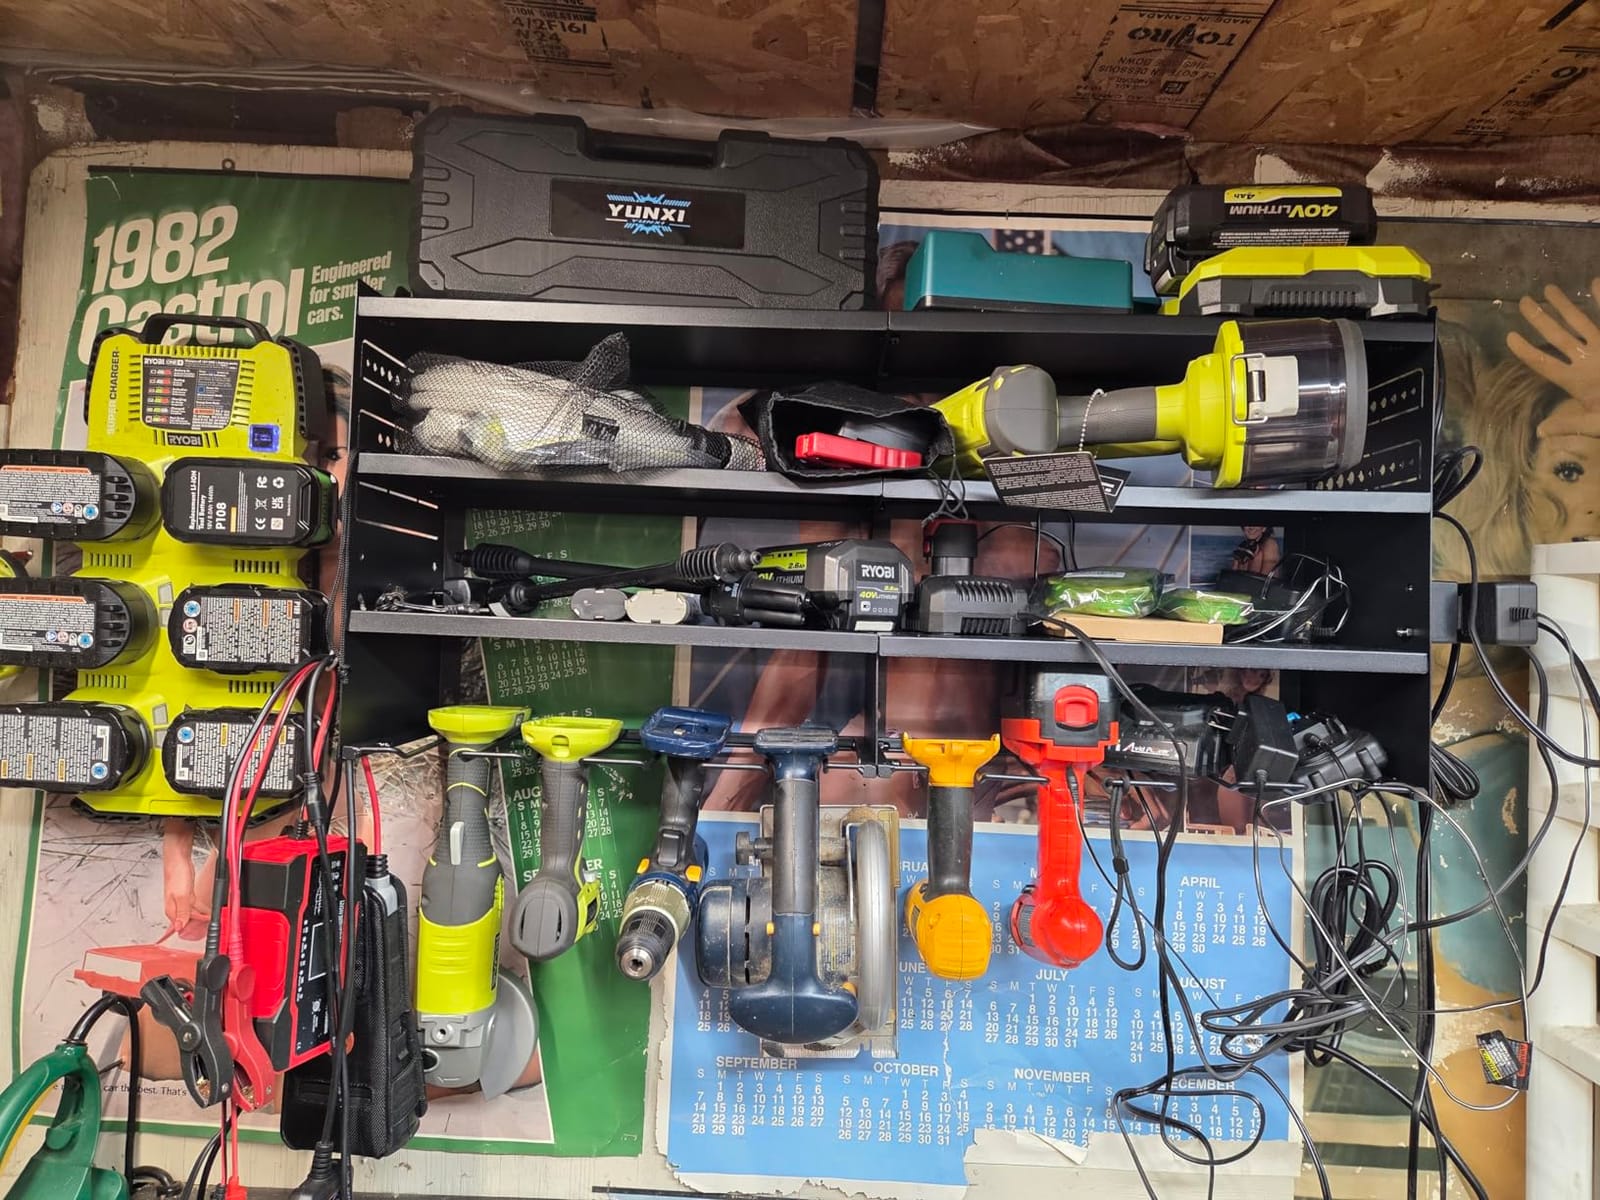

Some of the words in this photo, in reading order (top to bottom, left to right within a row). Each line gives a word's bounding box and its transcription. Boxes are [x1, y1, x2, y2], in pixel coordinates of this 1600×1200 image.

[1139, 12, 1191, 21] CANADA
[608, 203, 686, 222] YUNXI
[92, 205, 238, 295] 1982
[311, 251, 392, 284] Engineered
[309, 286, 331, 305] for
[307, 306, 343, 325] cars.
[144, 357, 165, 365] RYOBI
[169, 434, 201, 446] RYOBI
[216, 502, 227, 530] P108
[861, 564, 895, 579] RYOBI
[598, 817, 609, 827] 21
[600, 826, 612, 836] 28
[1180, 876, 1221, 888] APRIL
[1173, 921, 1186, 931] 15
[1193, 923, 1206, 933] 16
[1214, 924, 1226, 933] 17
[1233, 925, 1246, 935] 18
[1254, 926, 1266, 936] 19
[1172, 932, 1186, 942] 22
[1192, 933, 1206, 943] 23
[1212, 934, 1225, 944] 24
[1232, 935, 1245, 946] 25
[1252, 937, 1266, 947] 26
[899, 962, 926, 973] UNE
[1036, 969, 1068, 981] JULY
[989, 981, 998, 992] S
[1010, 981, 1019, 991] M
[1029, 982, 1036, 992] T
[1047, 984, 1057, 993] W
[1069, 985, 1075, 996] T
[1089, 986, 1096, 995] F
[1108, 986, 1115, 996] S
[1178, 977, 1226, 989] UGUST
[987, 1012, 999, 1022] 13
[1006, 1013, 1019, 1024] 14
[1027, 1015, 1039, 1027] 15
[1046, 1016, 1059, 1026] 16
[1066, 1017, 1079, 1027] 17
[1086, 1018, 1098, 1028] 18
[1105, 1019, 1118, 1029] 19
[985, 1032, 999, 1043] 27
[1005, 1034, 1018, 1044] 28
[1025, 1036, 1039, 1046] 29
[1045, 1037, 1058, 1047] 30
[1064, 1038, 1077, 1048] 31
[715, 1056, 797, 1070] SEPTEMBER
[873, 1062, 939, 1077] OCTOBER
[697, 1068, 704, 1078] S
[718, 1069, 726, 1079] M
[737, 1071, 744, 1080] T
[755, 1072, 765, 1081] W
[776, 1072, 783, 1082] T
[796, 1073, 803, 1082] F
[815, 1073, 822, 1083] S
[1014, 1068, 1090, 1083] NOVEMBER
[160, 1086, 187, 1096] That's
[1171, 1078, 1236, 1091] ECEMBER
[697, 1091, 704, 1102] 7
[717, 1092, 724, 1103] 8
[737, 1093, 743, 1103] 9
[754, 1094, 766, 1104] 10
[772, 1094, 784, 1106] 11
[792, 1095, 805, 1105] 12
[813, 1095, 824, 1106] 13
[694, 1102, 706, 1112] 14
[714, 1103, 726, 1113] 15
[734, 1103, 746, 1114] 16
[753, 1104, 765, 1115] 17
[773, 1105, 785, 1116] 18
[792, 1106, 804, 1116] 19
[811, 1106, 824, 1116] 20
[840, 1107, 852, 1118] 12
[859, 1108, 872, 1119] 13
[880, 1109, 891, 1119] 14
[899, 1110, 911, 1121] 15
[920, 1112, 931, 1123] 16
[939, 1113, 951, 1124] 17
[692, 1113, 705, 1123] 21
[712, 1114, 726, 1124] 22
[732, 1114, 745, 1125] 23
[751, 1115, 765, 1125] 24
[771, 1116, 785, 1126] 25
[791, 1117, 804, 1127] 26
[810, 1117, 824, 1127] 27
[692, 1124, 706, 1134] 28
[712, 1124, 725, 1135] 29
[732, 1124, 745, 1135] 30
[839, 1129, 851, 1140] 26
[858, 1130, 871, 1141] 27
[879, 1131, 892, 1142] 28
[898, 1132, 912, 1143] 29
[918, 1134, 931, 1144] 30
[938, 1135, 949, 1145] 31
